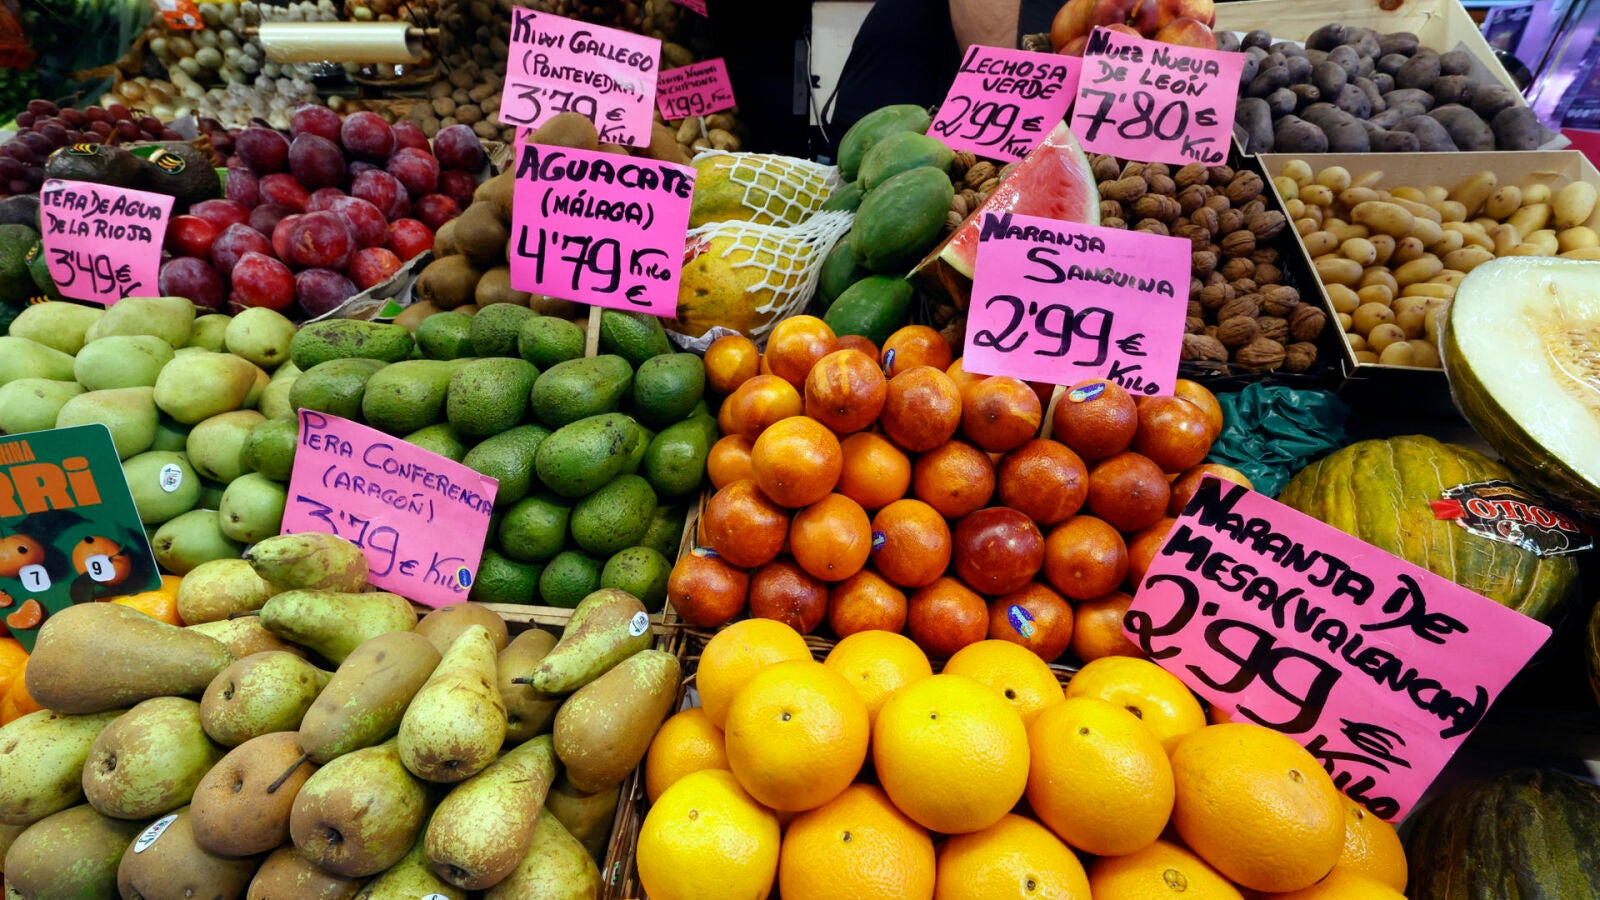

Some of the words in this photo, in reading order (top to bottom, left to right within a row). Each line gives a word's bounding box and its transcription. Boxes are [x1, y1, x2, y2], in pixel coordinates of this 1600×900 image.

[569, 31, 653, 72] GALLEGO
[959, 47, 1067, 83] LECHOSA
[1085, 29, 1143, 63] NUEZ
[1151, 47, 1219, 77] NUEVA
[1092, 60, 1128, 84] DE
[983, 78, 1062, 99] VERDE
[606, 108, 626, 121] €
[934, 96, 1020, 146] 2'99
[1022, 116, 1044, 132] €
[1077, 87, 1189, 142] 7'80
[1195, 108, 1218, 126] €
[1180, 135, 1224, 163] KILO
[516, 145, 695, 198] AGUACATE
[82, 190, 110, 218] DE
[110, 195, 161, 220] AGUA
[541, 188, 654, 230] (MÁLAGA)
[46, 212, 66, 235] DE
[69, 219, 89, 237] LA
[94, 219, 151, 243] RIOJA
[979, 212, 1106, 253] NARANJA
[50, 248, 115, 294] 3'49
[115, 264, 132, 283] €
[517, 225, 621, 293] 4'79
[1024, 247, 1174, 298] SANGUINA
[625, 285, 652, 306] €
[973, 295, 1114, 366] 2'99
[1115, 333, 1148, 356] €
[1107, 360, 1160, 395] KILO
[302, 411, 353, 458] PERA
[363, 443, 494, 516] CONFERENCIA
[1466, 498, 1580, 533] BOLLO
[30, 571, 40, 585] 7
[92, 561, 102, 575] 9
[400, 560, 419, 576] €
[1182, 478, 1376, 606] NARANJA
[1360, 574, 1469, 644] DE
[1122, 574, 1342, 733] 2'99
[1340, 717, 1411, 768] €
